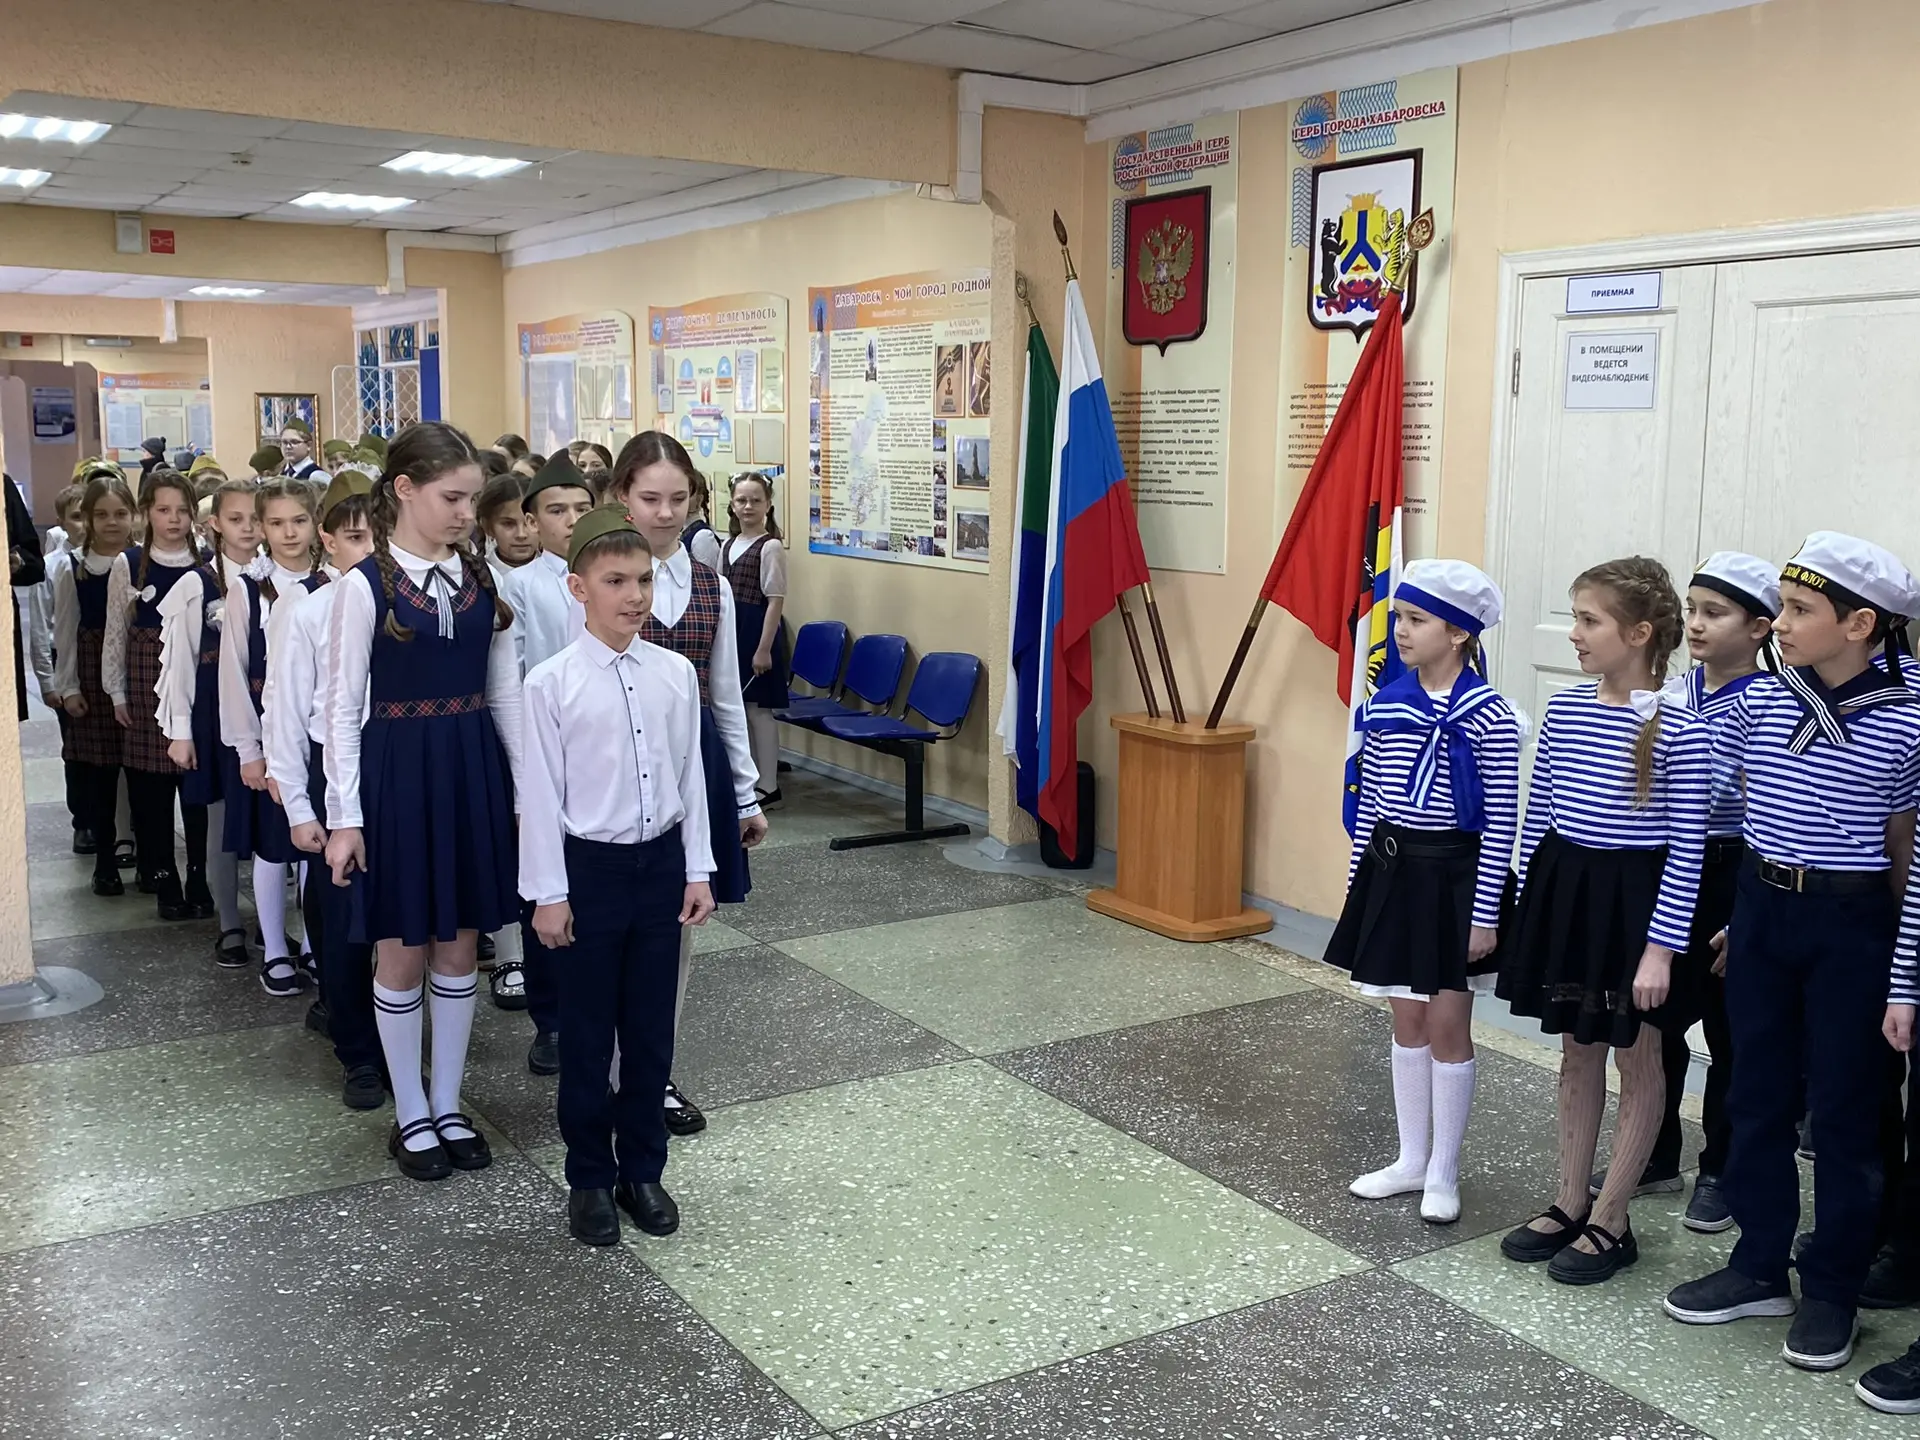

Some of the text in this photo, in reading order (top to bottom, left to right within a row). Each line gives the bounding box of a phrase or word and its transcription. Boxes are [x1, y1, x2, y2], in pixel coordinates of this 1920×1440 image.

[1294, 101, 1446, 139] ГЕРБ ГОРОДА ХАБАРОВСКА
[1116, 136, 1230, 168] ГОСУДАРСТВЕННЫЙ ГЕРБ
[1116, 151, 1230, 181] РОССИЙСКОЙ ФЕДЕРАЦИИ
[835, 276, 991, 307] ХАБАРОВСК МОЙ ГОРОД РОДНОЙ
[1591, 288, 1634, 298] ПРИЕМНАЯ
[1580, 345, 1643, 355] В ПОМЕЩЕНИИ
[1593, 360, 1628, 369] ВЕДЕТСЯ
[1571, 373, 1649, 383] ВИДЕОНАБЛЮДЕНИЕ
[1801, 571, 1828, 588] ФЛОТ
